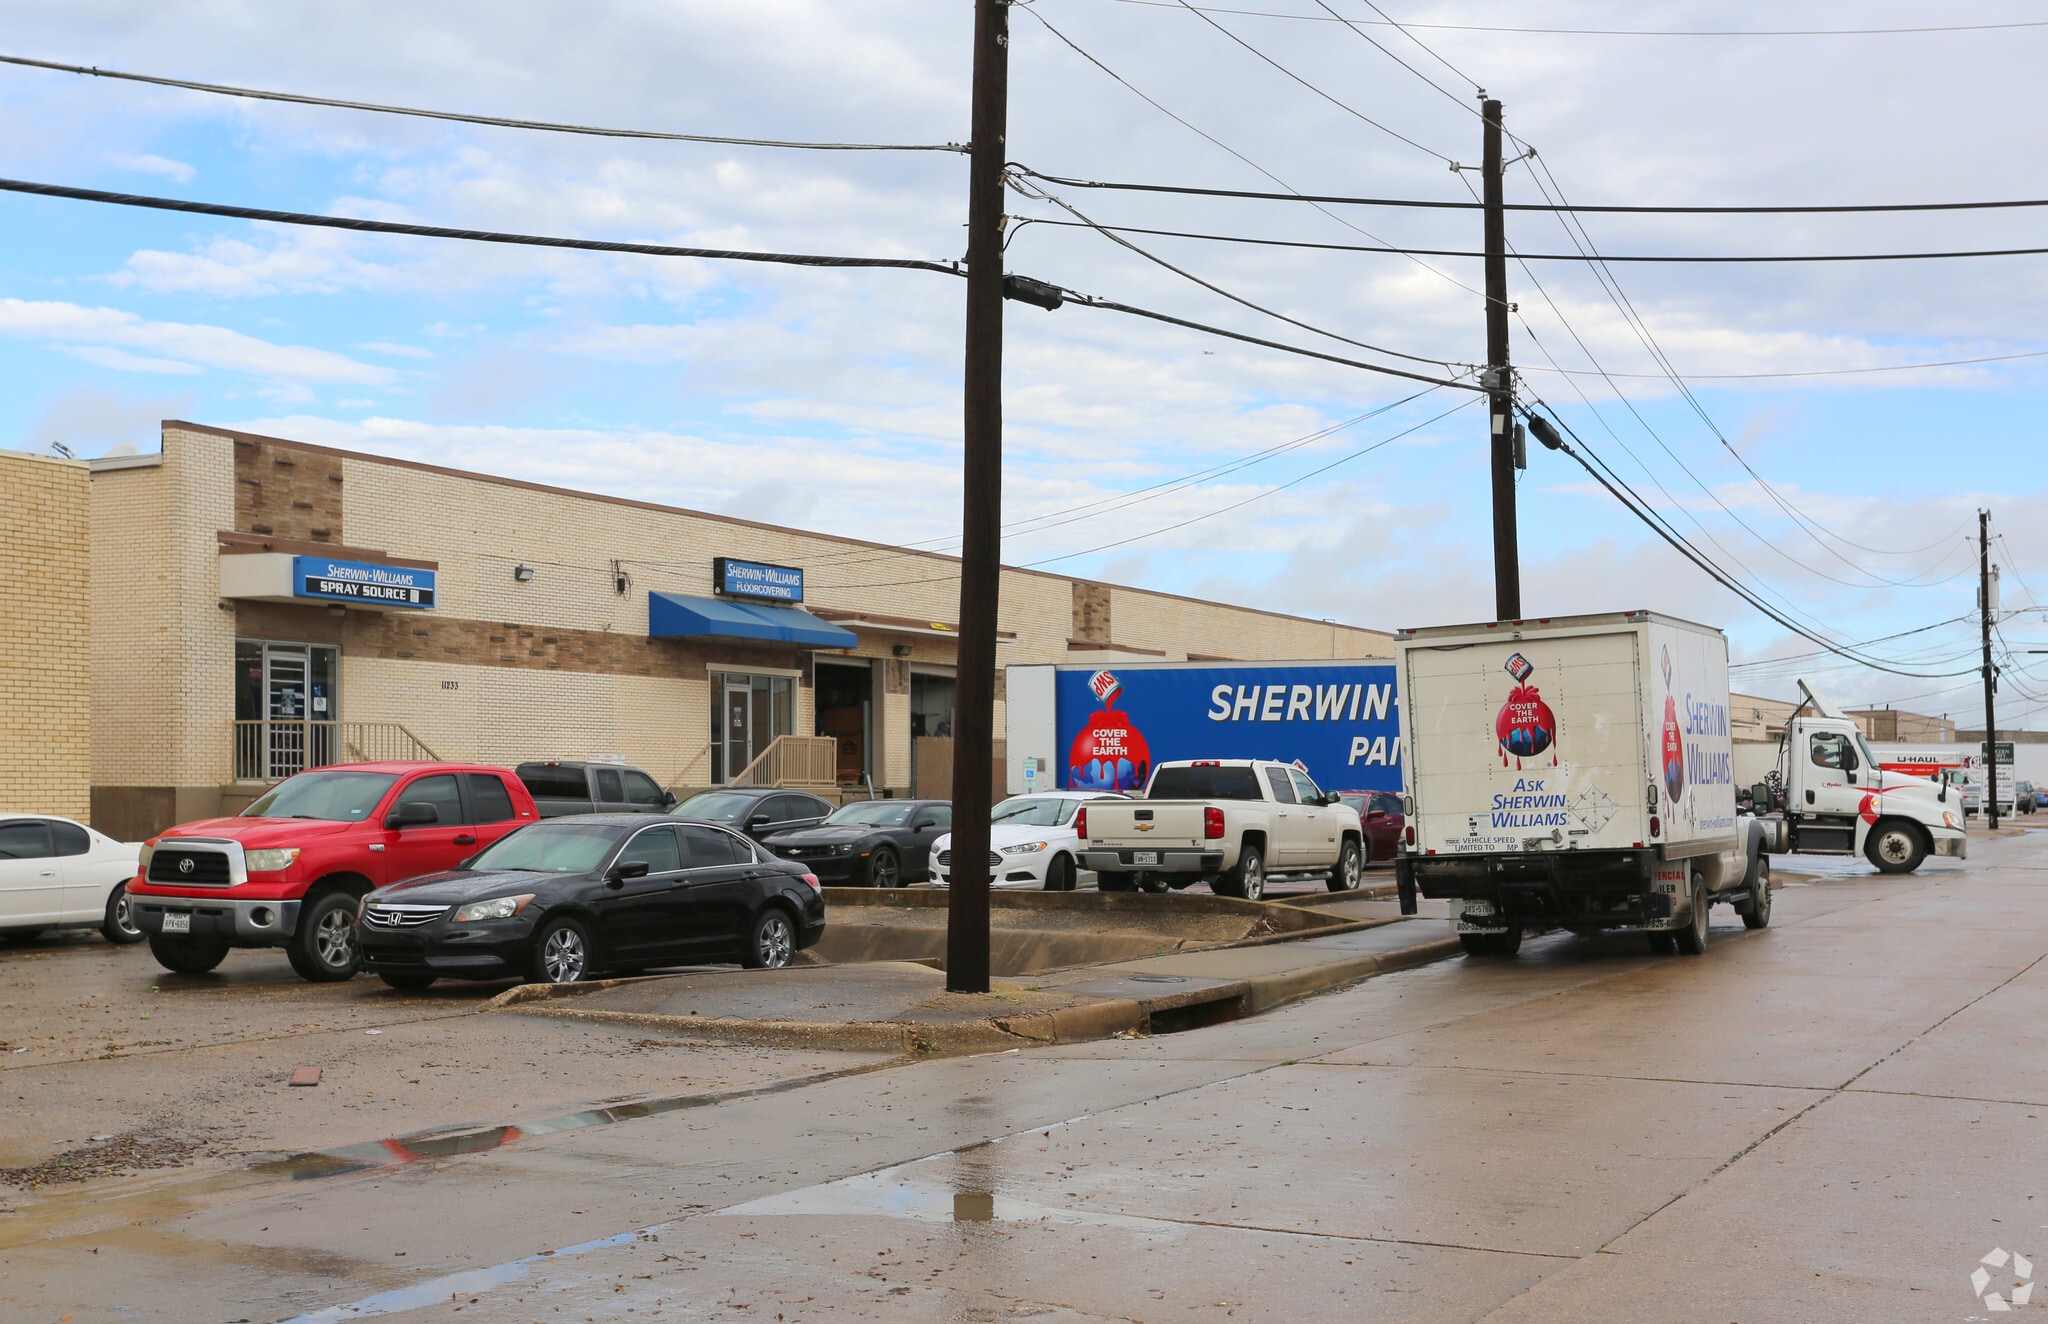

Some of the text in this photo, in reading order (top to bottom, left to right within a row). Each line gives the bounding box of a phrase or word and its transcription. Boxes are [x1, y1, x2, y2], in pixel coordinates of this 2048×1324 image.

[327, 564, 414, 586] SHERWIN-WILLIAMS
[727, 563, 800, 586] SHERWIN-WILLIAMS
[320, 580, 407, 600] SPRAY SOURCE
[736, 581, 791, 598] FLOORCOVERING
[1509, 656, 1526, 676] SWP
[441, 680, 459, 690] 11233
[1093, 671, 1115, 697] SWP
[1509, 702, 1538, 711] COVER
[1516, 709, 1533, 717] THE
[1511, 716, 1539, 724] EARTH
[1685, 692, 1727, 737] SHERWIN
[1092, 728, 1128, 738] COVER
[1099, 737, 1121, 746] THE
[1092, 746, 1128, 756] EARTH
[1347, 736, 1401, 766] PAI
[1686, 743, 1730, 785] WILLIAMS
[1513, 778, 1545, 792] ASK
[1491, 793, 1566, 810] SHERWIN
[1491, 812, 1568, 828] WILLIAMS
[1485, 843, 1495, 851] TO
[1493, 836, 1516, 844] SPEED
[1655, 871, 1685, 880] ERCIAL
[1657, 884, 1676, 893] ILER
